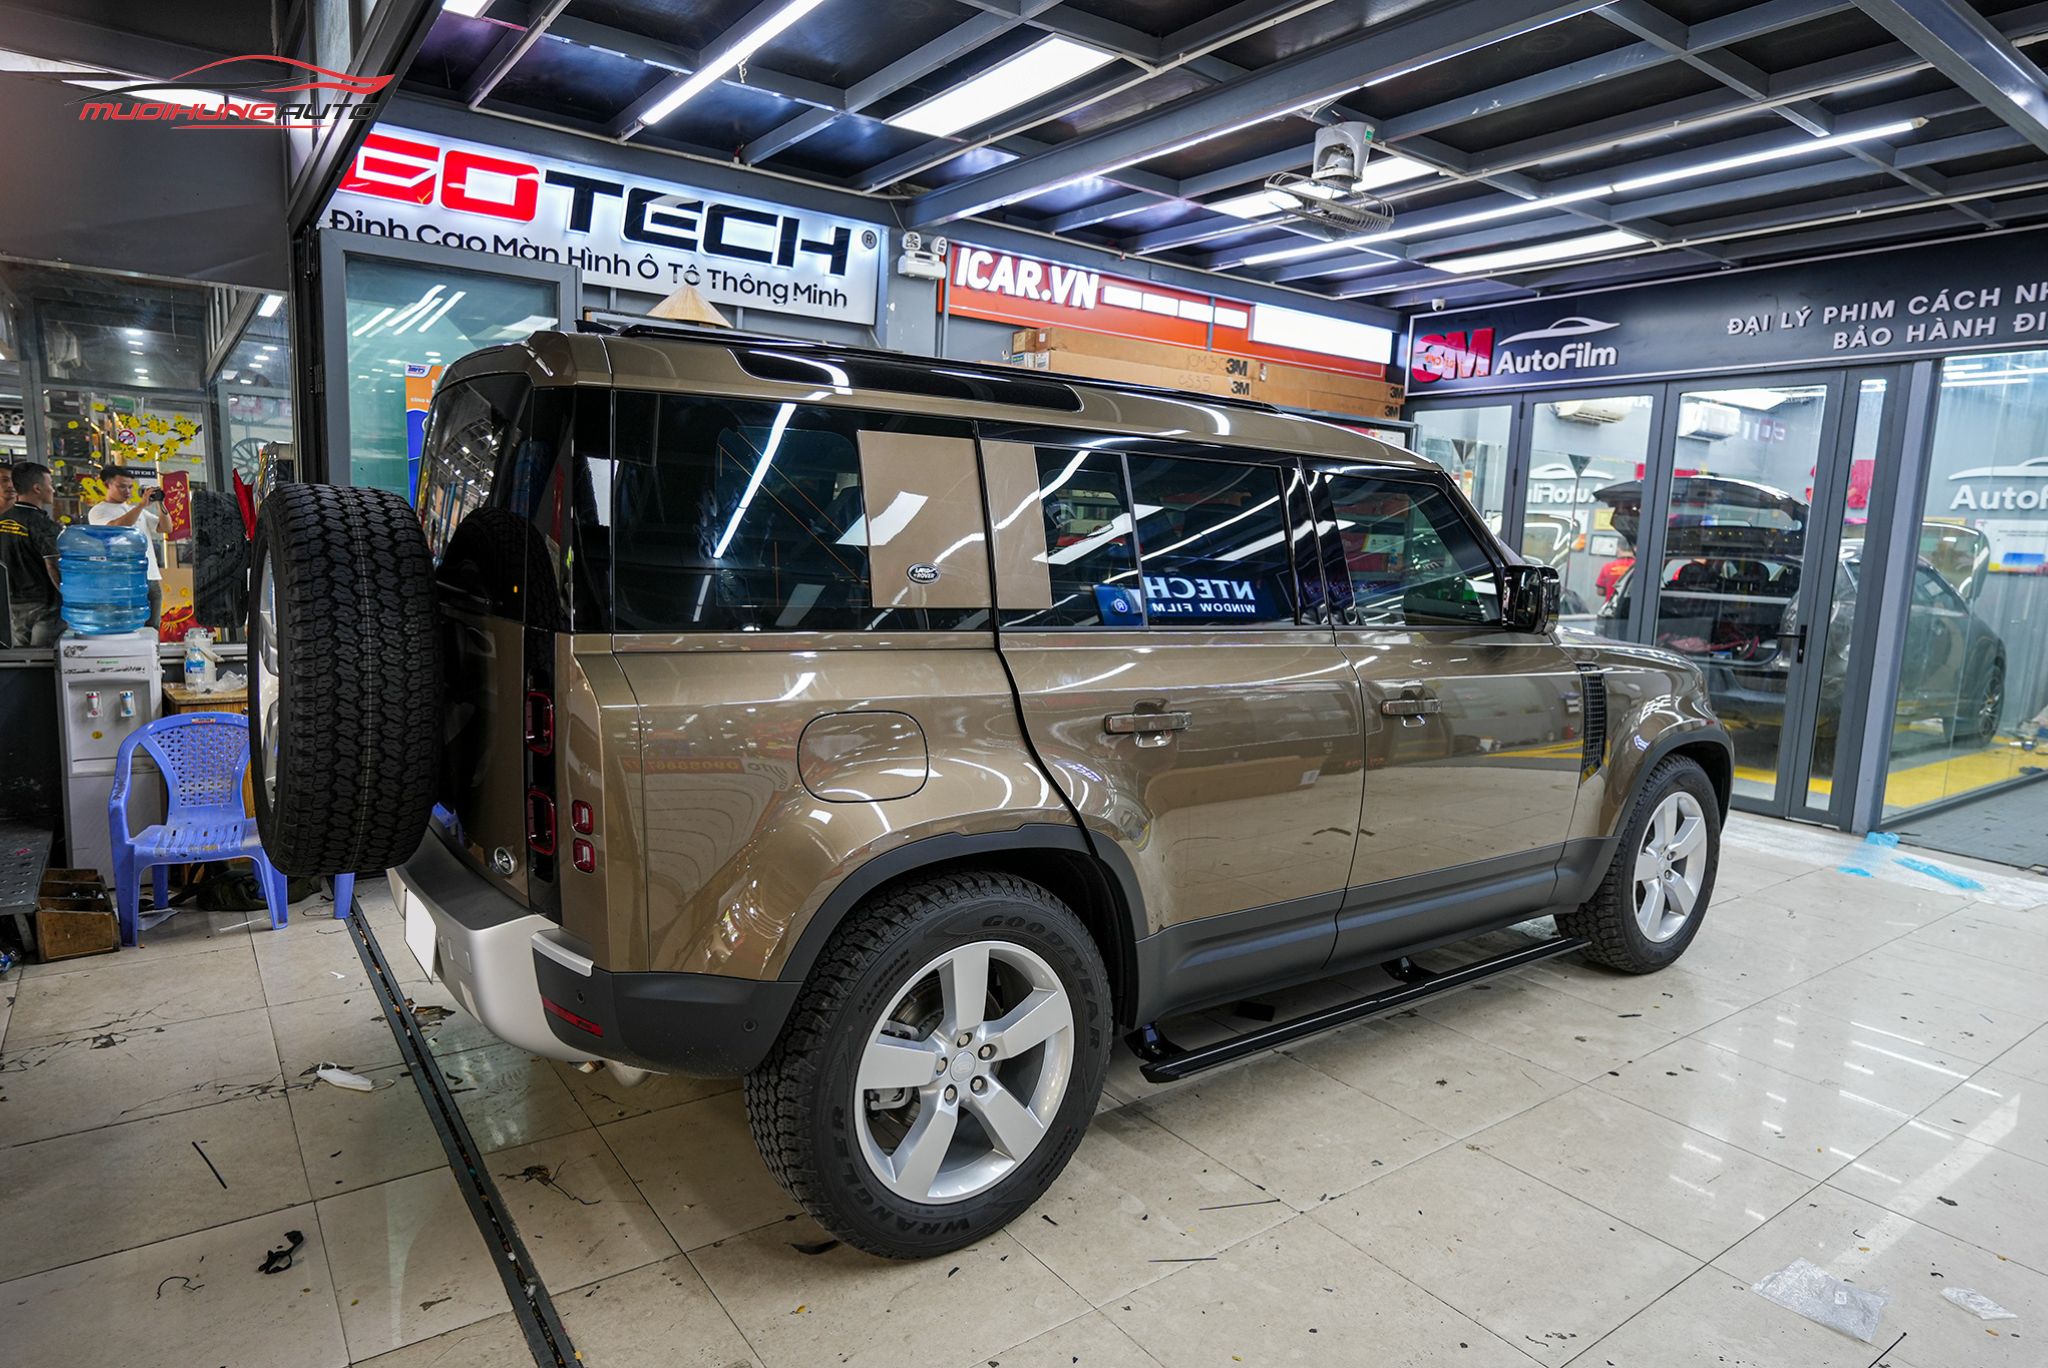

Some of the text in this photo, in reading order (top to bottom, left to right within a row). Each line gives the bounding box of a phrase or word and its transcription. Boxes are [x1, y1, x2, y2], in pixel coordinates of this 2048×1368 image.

[416, 224, 486, 252] Cao
[493, 235, 560, 264] Màn
[567, 246, 631, 277] Hình
[637, 254, 660, 280] Ô
[668, 263, 701, 286] Tô
[707, 268, 789, 307] Thông
[792, 283, 848, 309] Minh
[955, 247, 1100, 310] ICAR.VN
[1727, 314, 1770, 336] ĐẠI
[1780, 305, 1812, 329] LÝ
[1823, 299, 1896, 325] PHIM
[1907, 288, 2001, 316] CÁCH
[1833, 324, 1893, 350] BẢO
[1906, 316, 1997, 343] HÀNH
[1225, 358, 1248, 377] 3M
[1411, 327, 1495, 383] 3M
[1495, 341, 1618, 376] AutoFilm
[1231, 380, 1250, 396] 3M
[1389, 385, 1404, 399] 3M
[1384, 405, 1398, 418] 3M
